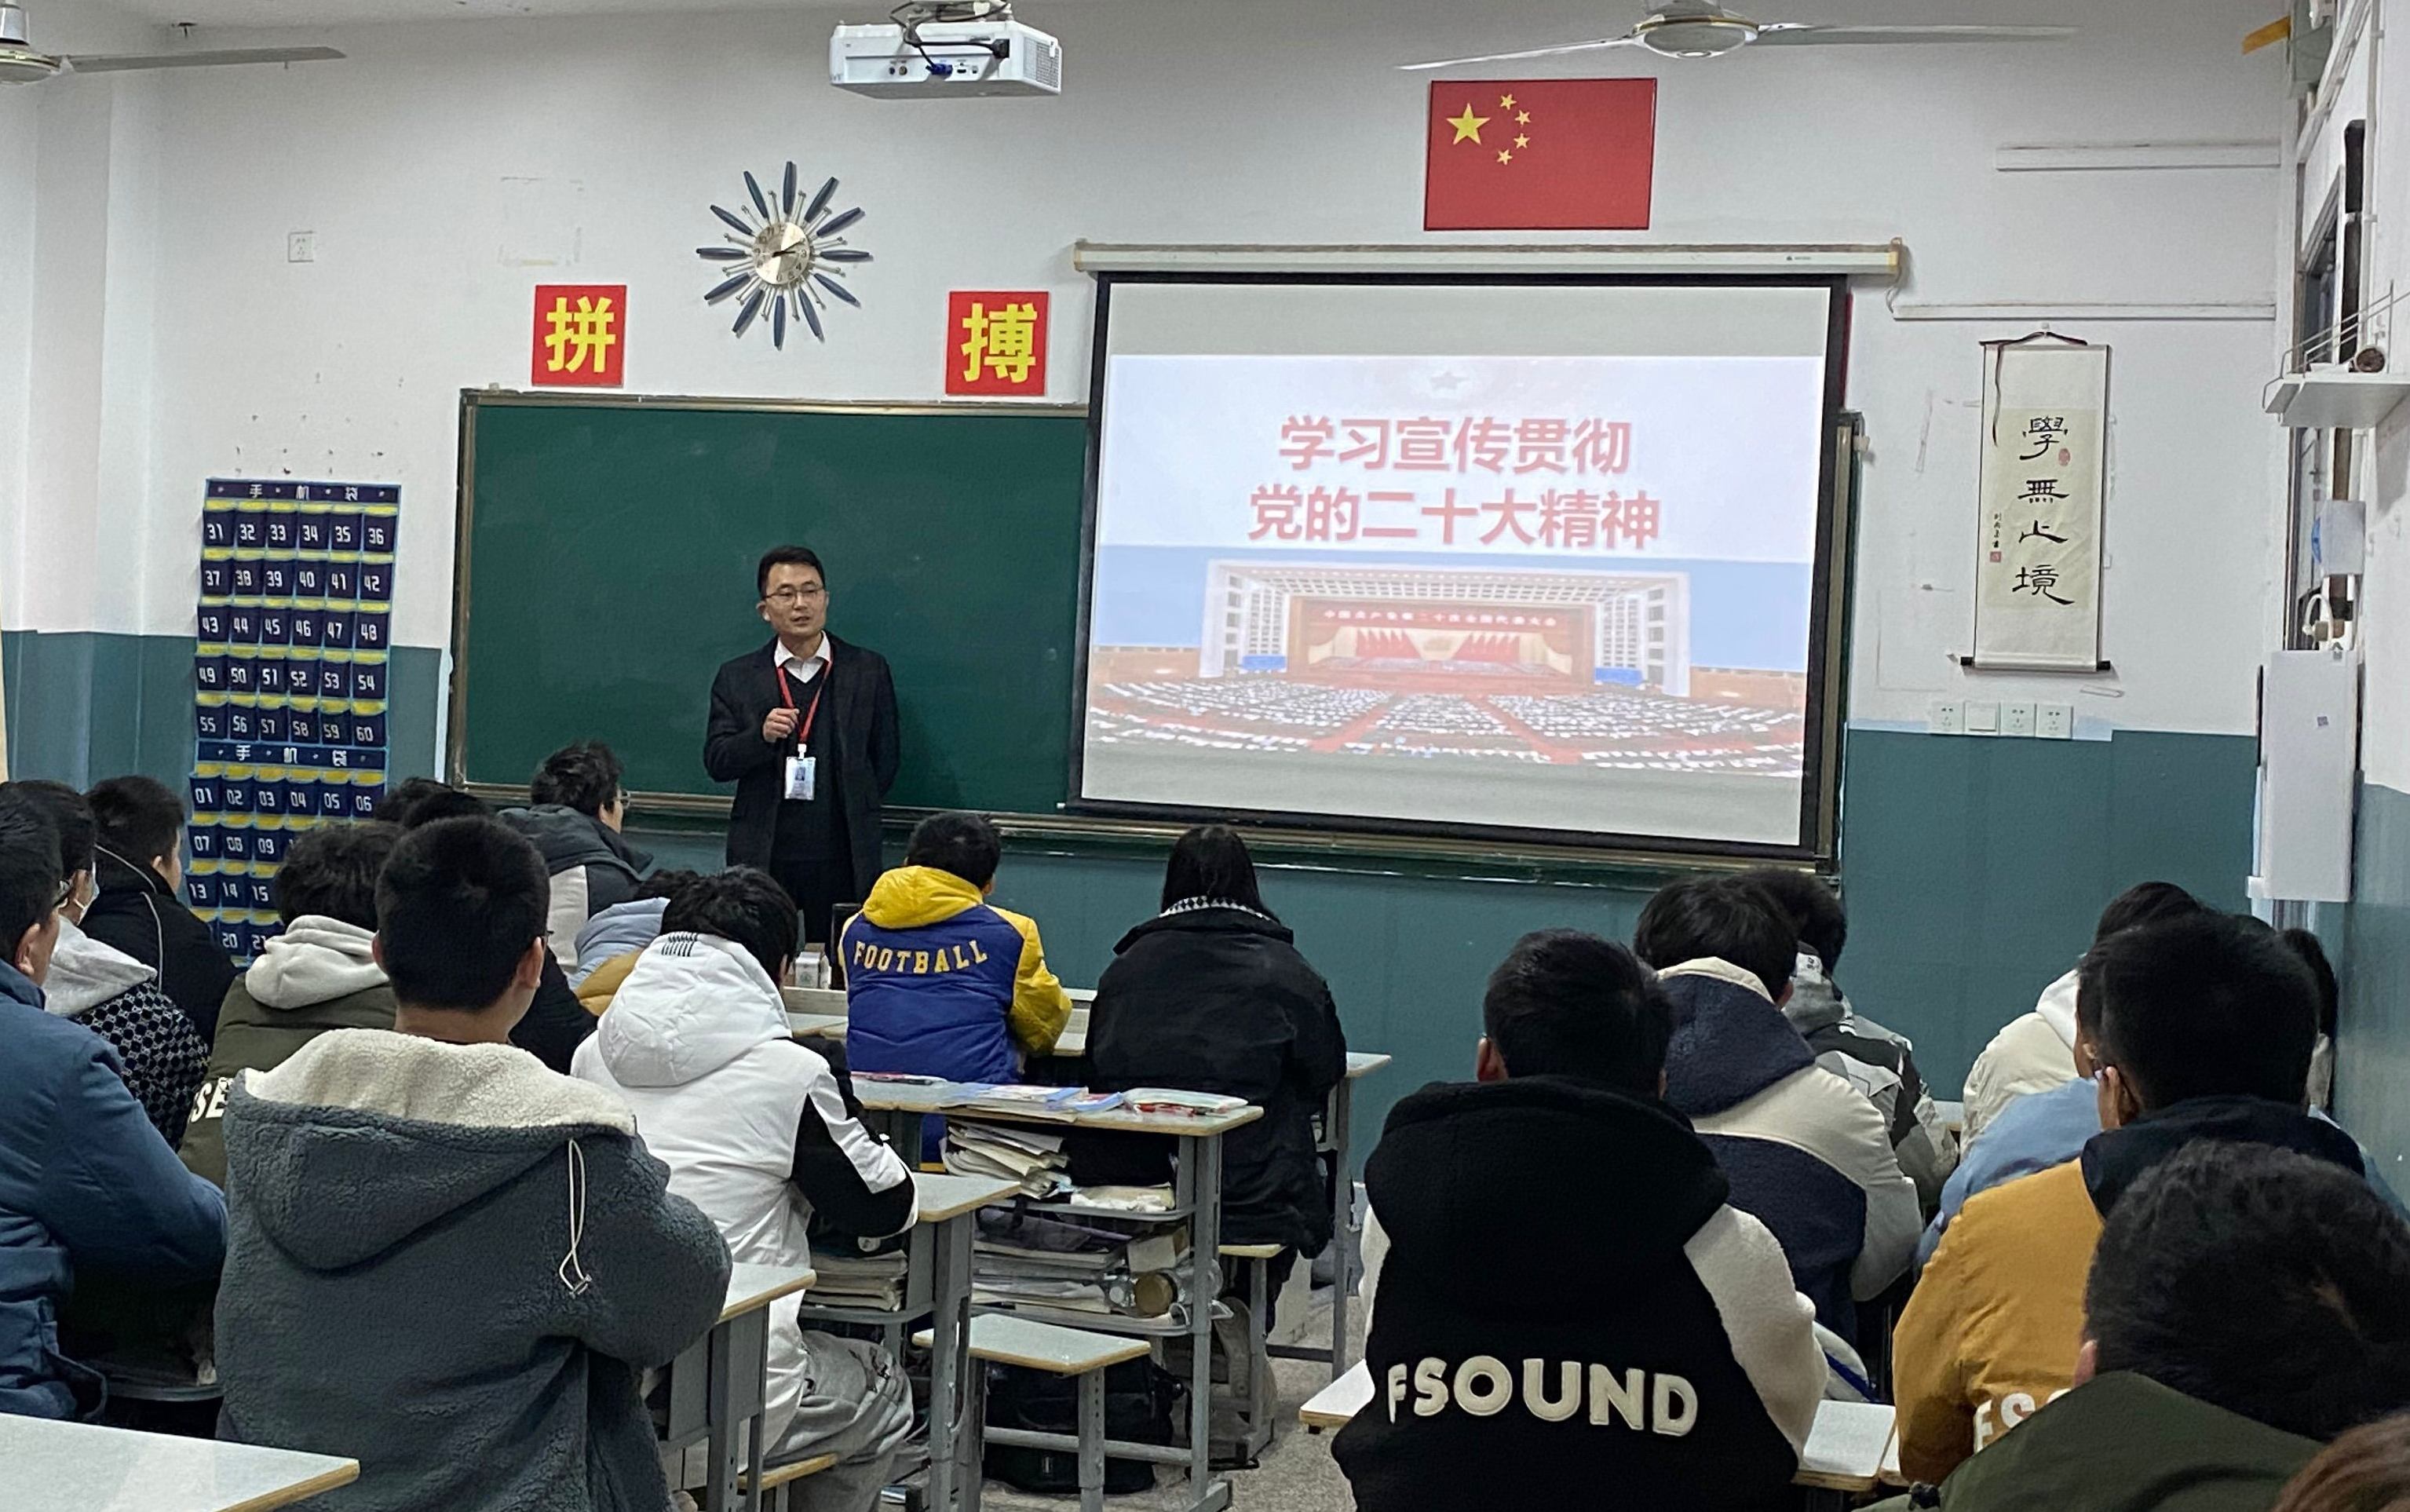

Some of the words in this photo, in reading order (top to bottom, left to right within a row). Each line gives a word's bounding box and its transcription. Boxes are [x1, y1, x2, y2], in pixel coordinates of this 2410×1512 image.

[546, 297, 615, 373] 拼
[962, 303, 1038, 383] 搏
[1279, 415, 1631, 476] 学习宣传贯彻
[1247, 483, 1661, 550] 党的二十大精神
[2012, 415, 2075, 605] 學無止境
[207, 524, 223, 539] 31
[240, 524, 256, 540] 32
[271, 524, 287, 541] 33
[302, 524, 318, 542] 34
[335, 526, 351, 542] 35
[368, 528, 384, 545] 36
[206, 570, 220, 586] 37
[236, 570, 251, 586] 38
[266, 571, 283, 587] 39
[300, 572, 315, 588] 40
[331, 573, 346, 590] 41
[363, 575, 380, 592] 42
[202, 617, 218, 634] 43
[234, 618, 248, 634] 44
[265, 619, 280, 635] 45
[296, 620, 311, 636] 46
[327, 623, 342, 638] 47
[360, 624, 377, 641] 48
[199, 667, 215, 683] 49
[231, 668, 246, 684] 50
[262, 669, 277, 685] 51
[290, 671, 308, 687] 52
[324, 672, 339, 689] 53
[358, 675, 374, 690] 54
[199, 717, 216, 732] 55
[233, 715, 247, 732] 56
[261, 718, 276, 734] 57
[293, 721, 309, 736] 58
[323, 724, 339, 740] 59
[356, 726, 373, 742] 60
[196, 788, 212, 804] 01
[227, 791, 243, 805] 02
[259, 791, 275, 806] 03
[290, 791, 305, 808] 04
[324, 793, 340, 809] 05
[356, 795, 371, 811] 06
[195, 835, 210, 851] 07
[227, 837, 243, 852] 08
[258, 838, 274, 854] 09
[191, 885, 206, 899] 13
[253, 886, 268, 901] 15
[222, 933, 237, 948] 20
[854, 940, 988, 973] FOOTBALL
[1387, 1354, 1699, 1437] FSOUND
[1974, 1388, 2072, 1453] FS
